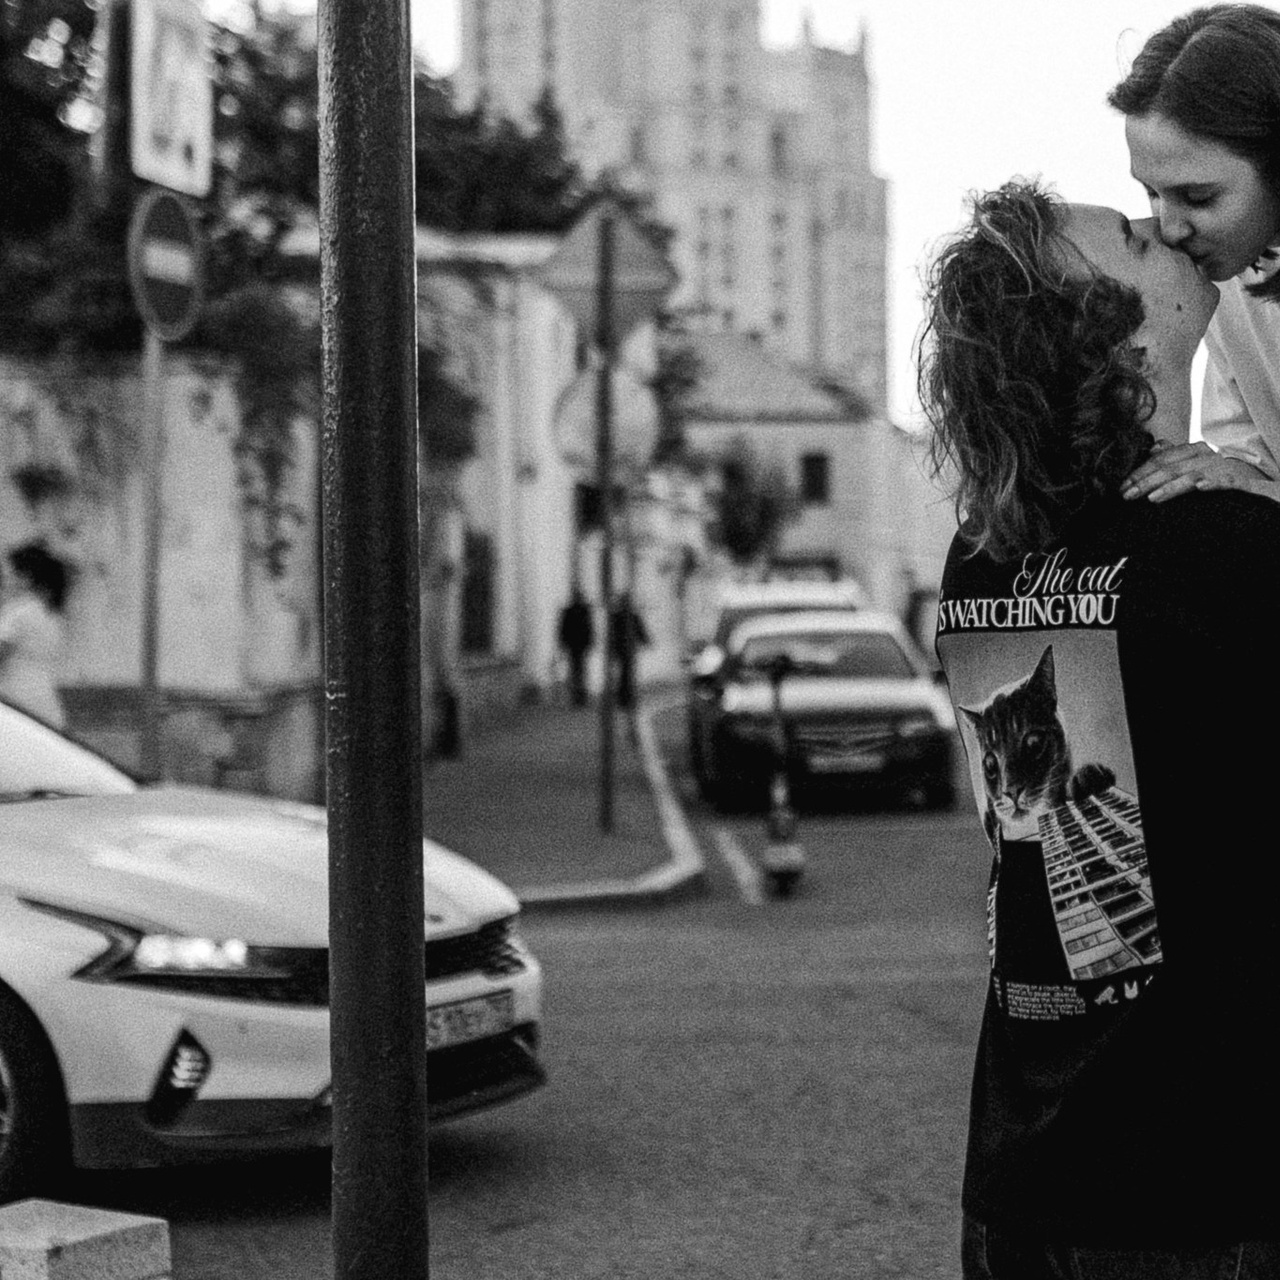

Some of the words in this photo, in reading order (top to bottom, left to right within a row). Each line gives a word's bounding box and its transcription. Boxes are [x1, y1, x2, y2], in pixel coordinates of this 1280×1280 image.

[1013, 547, 1074, 599] The
[1077, 556, 1128, 592] cat
[947, 594, 1065, 628] WATCHING
[1067, 593, 1120, 625] YOU
